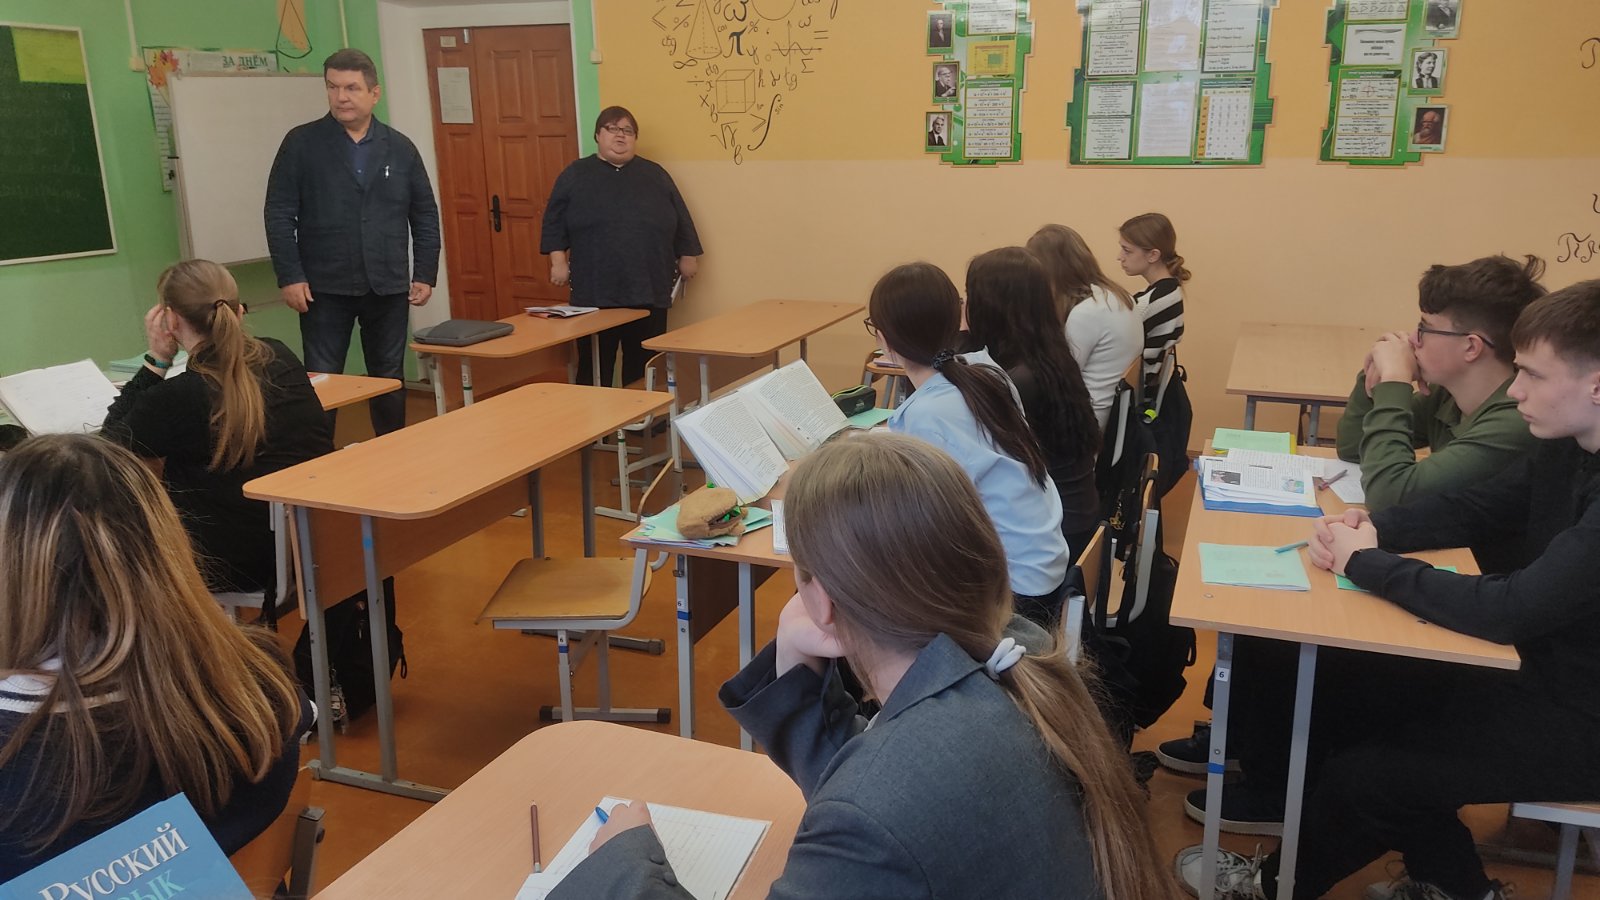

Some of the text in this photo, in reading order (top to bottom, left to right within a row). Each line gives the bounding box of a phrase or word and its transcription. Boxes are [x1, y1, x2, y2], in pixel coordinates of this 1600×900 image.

[222, 55, 268, 68] ЗА ДНЁМ
[1218, 671, 1225, 679] 6
